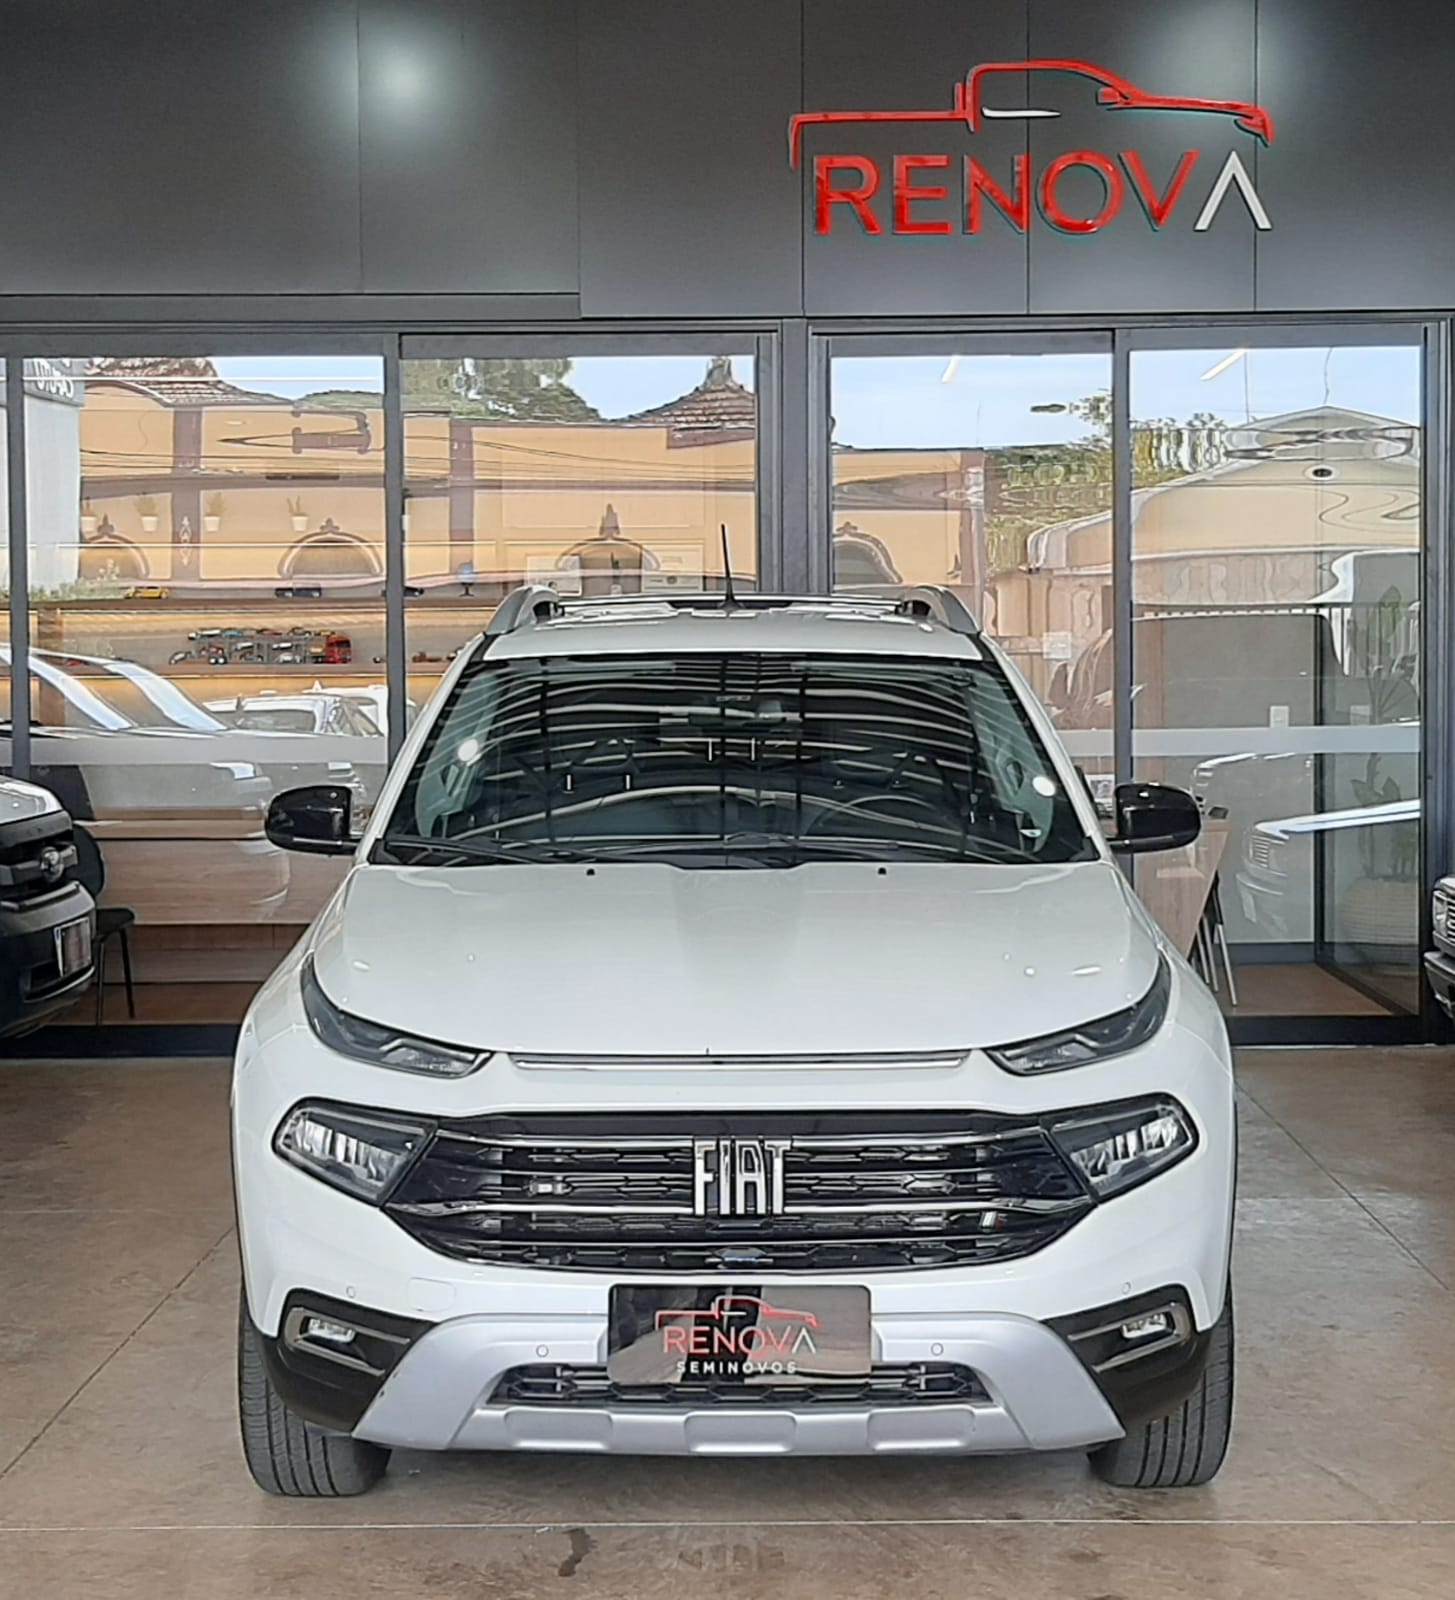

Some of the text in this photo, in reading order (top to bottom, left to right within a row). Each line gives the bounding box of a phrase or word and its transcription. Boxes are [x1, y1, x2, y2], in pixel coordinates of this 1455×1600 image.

[813, 149, 1273, 236] RENOVA
[694, 1140, 791, 1215] FIAT
[662, 1325, 817, 1356] RENOVA
[676, 1361, 797, 1374] SEMINOVOS
